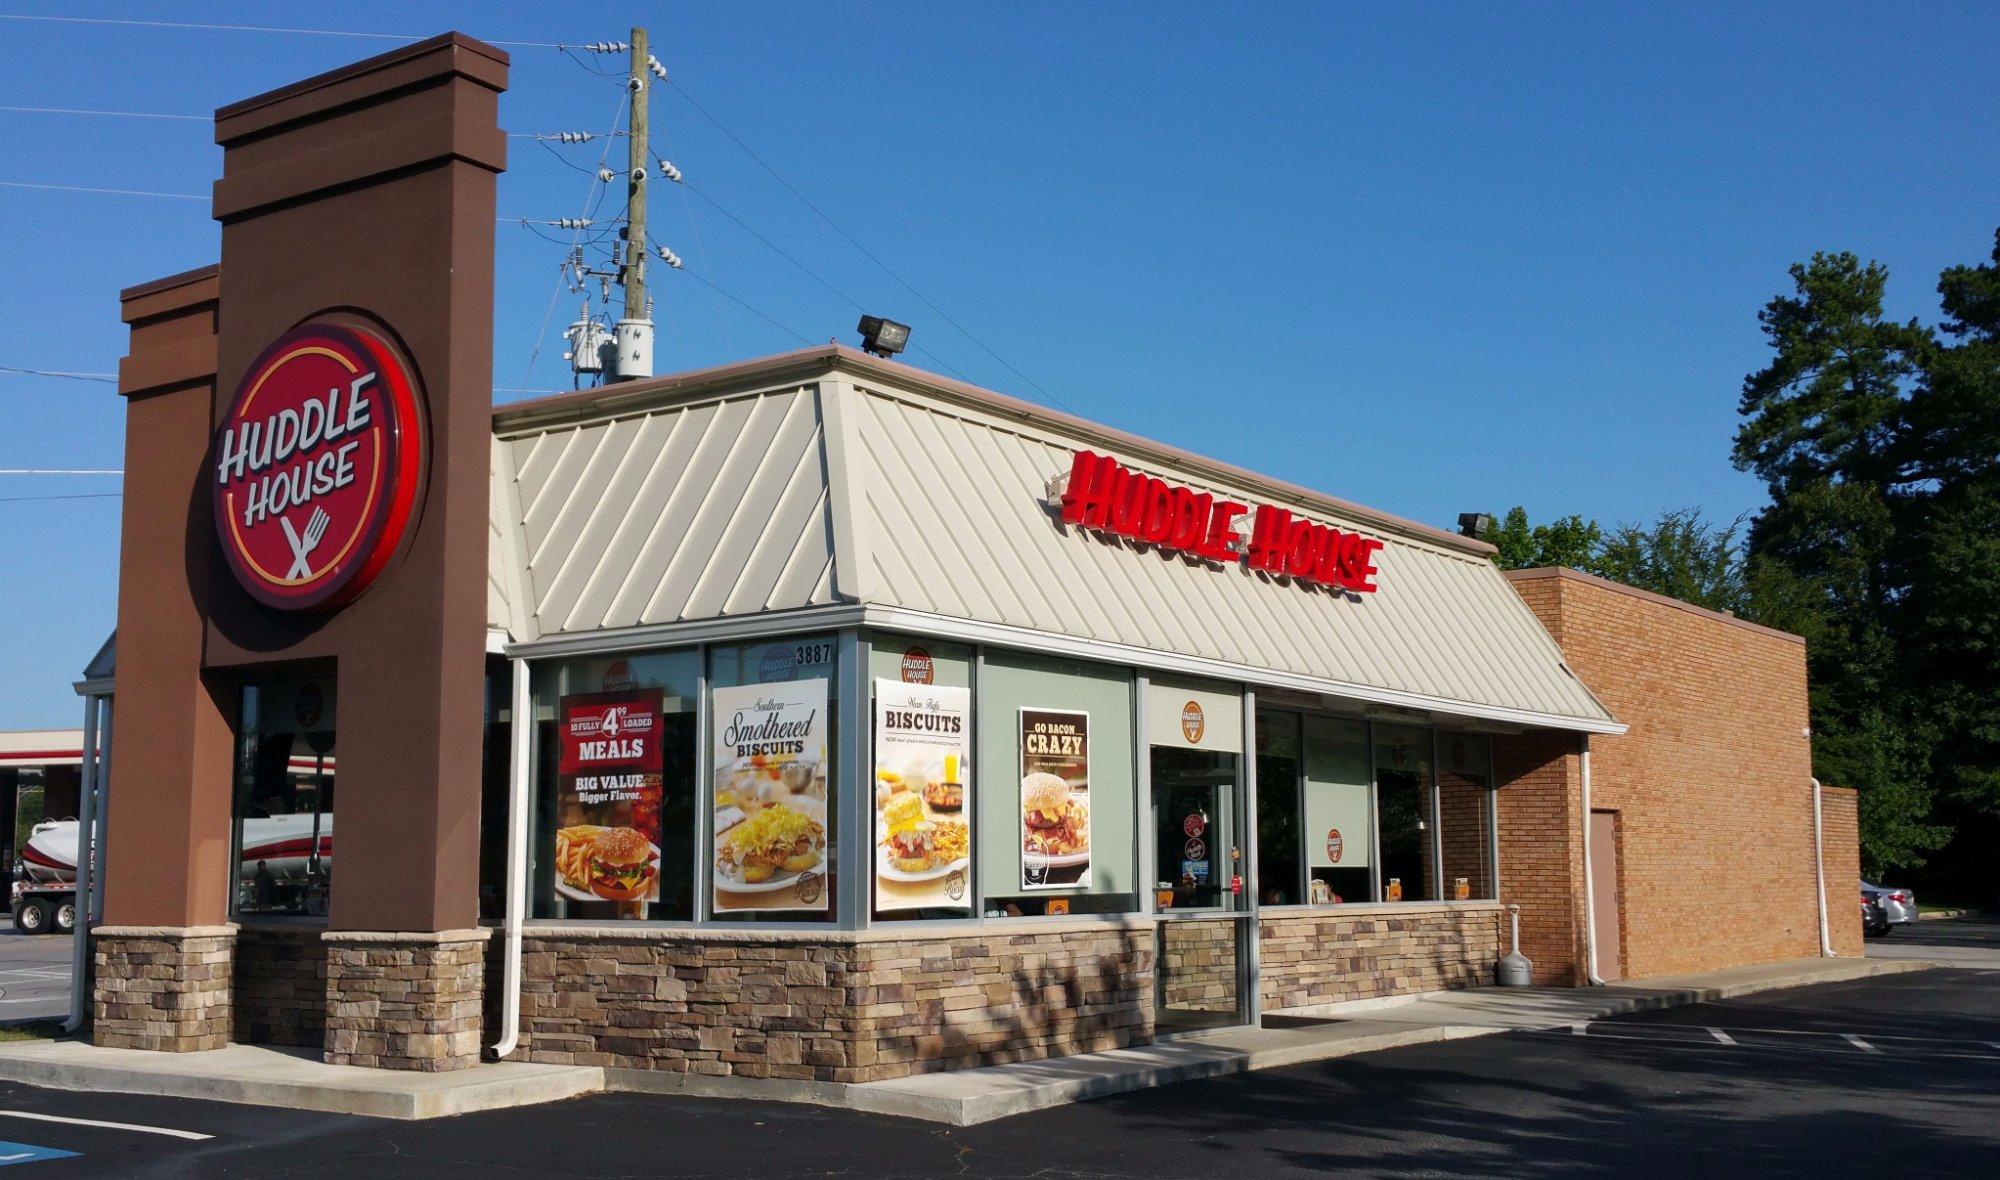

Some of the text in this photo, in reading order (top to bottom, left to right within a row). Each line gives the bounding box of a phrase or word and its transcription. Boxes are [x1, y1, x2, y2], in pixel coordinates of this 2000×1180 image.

[218, 371, 376, 484] HUDDLE
[244, 441, 359, 527] HOUSE
[1061, 450, 1384, 593] HUDDLE HOUSE
[797, 643, 830, 665] 3887
[903, 658, 931, 670] HUDDLE
[907, 670, 927, 679] HOUSE
[753, 697, 785, 712] Southern
[579, 721, 600, 731] FULLY
[623, 718, 652, 727] LOADED
[724, 708, 816, 748] Smothered
[886, 710, 961, 733] BISCUITS
[1034, 723, 1075, 735] GO BACON
[579, 738, 643, 760] MEALS
[737, 740, 804, 757] BISCUITS
[1027, 733, 1082, 755] CRAZY
[575, 776, 598, 790] BIG
[579, 790, 642, 804] Bigger Flavor.
